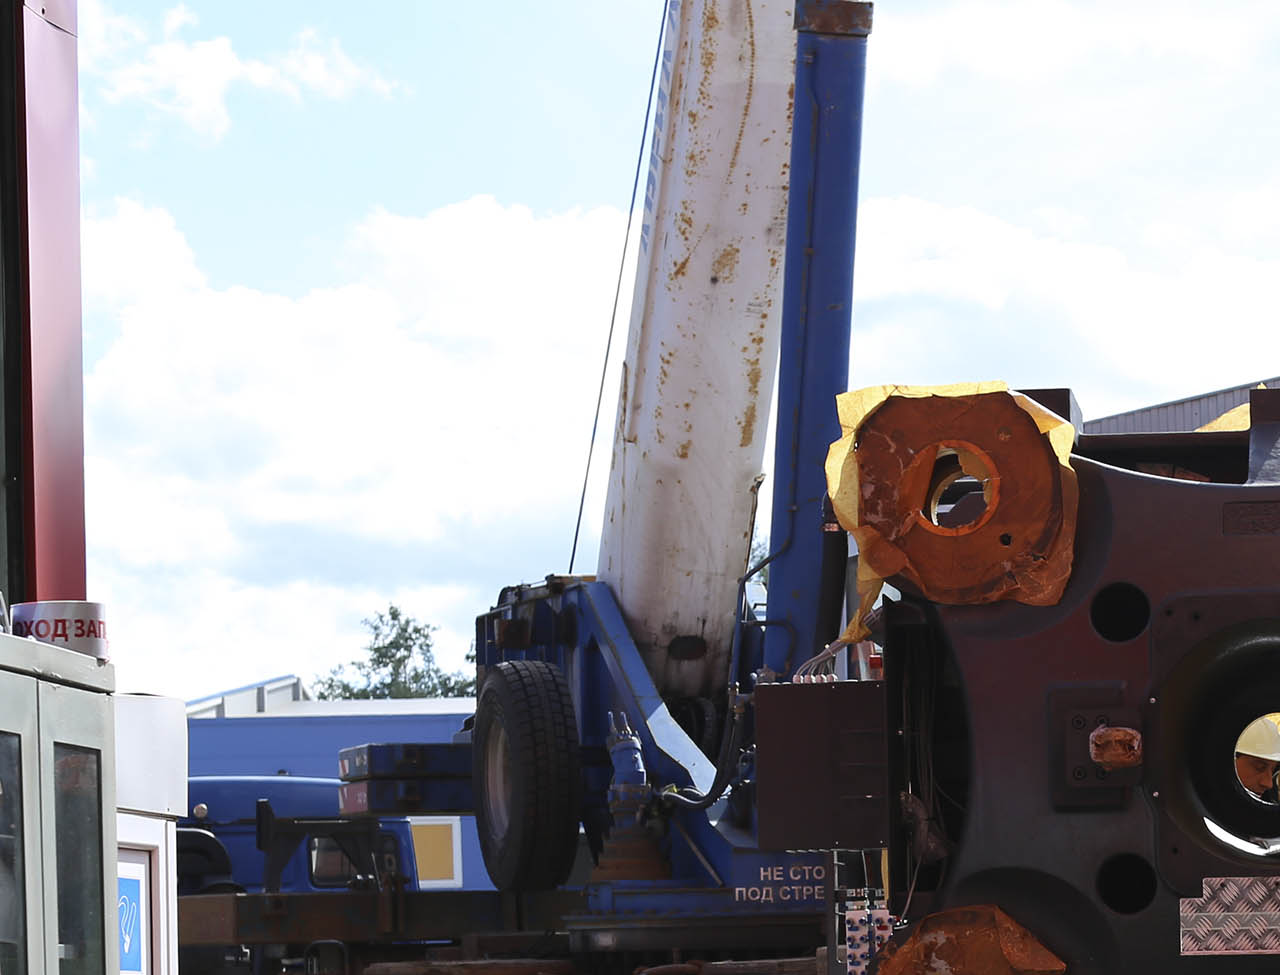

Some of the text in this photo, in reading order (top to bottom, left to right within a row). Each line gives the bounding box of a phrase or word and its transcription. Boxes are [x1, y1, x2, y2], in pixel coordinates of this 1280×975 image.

[760, 866, 825, 881] НЕ СТО
[735, 886, 825, 903] ПОД СТРЕ
